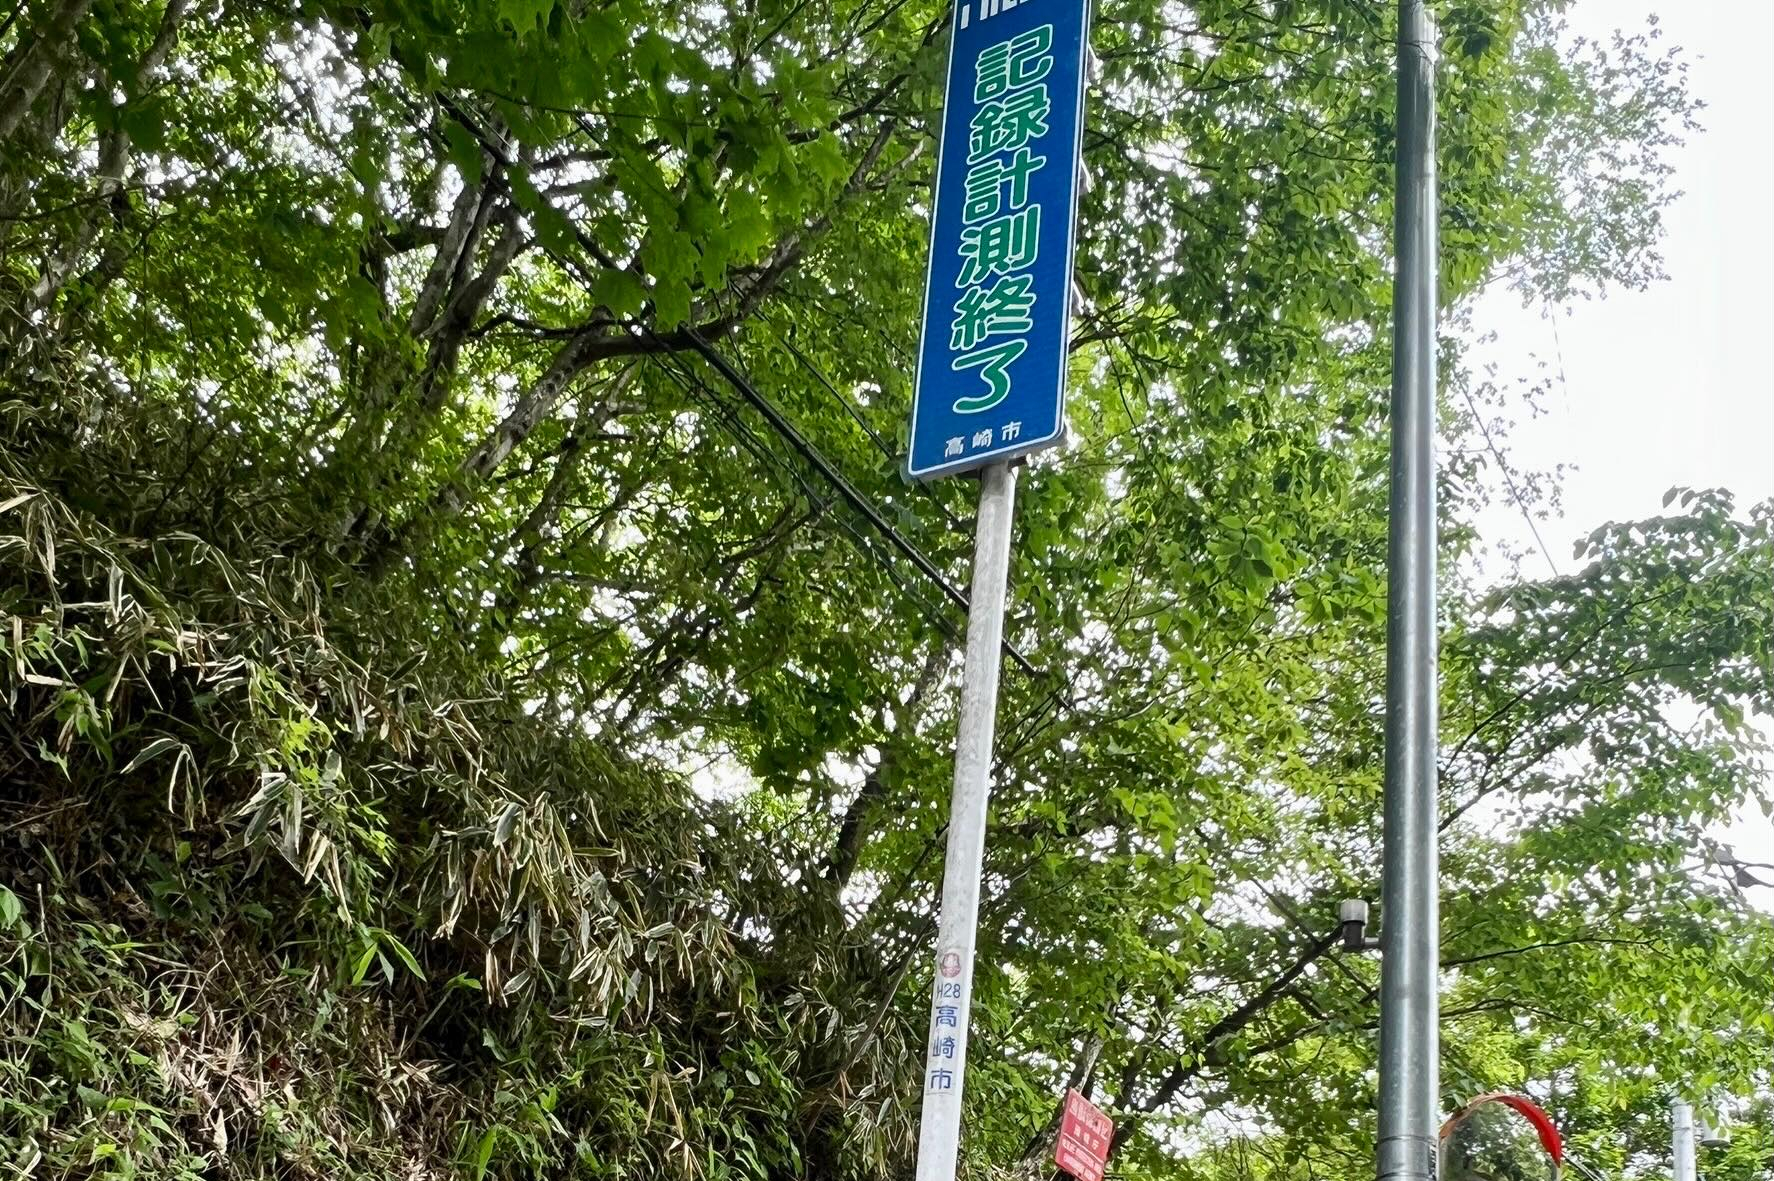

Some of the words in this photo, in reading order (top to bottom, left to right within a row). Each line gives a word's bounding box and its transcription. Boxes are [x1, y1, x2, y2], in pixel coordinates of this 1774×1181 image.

[950, 23, 1054, 414] 記録計測終了
[944, 421, 1022, 458] 高崎市
[936, 982, 961, 1000] H28
[931, 1004, 959, 1090] 高崎市
